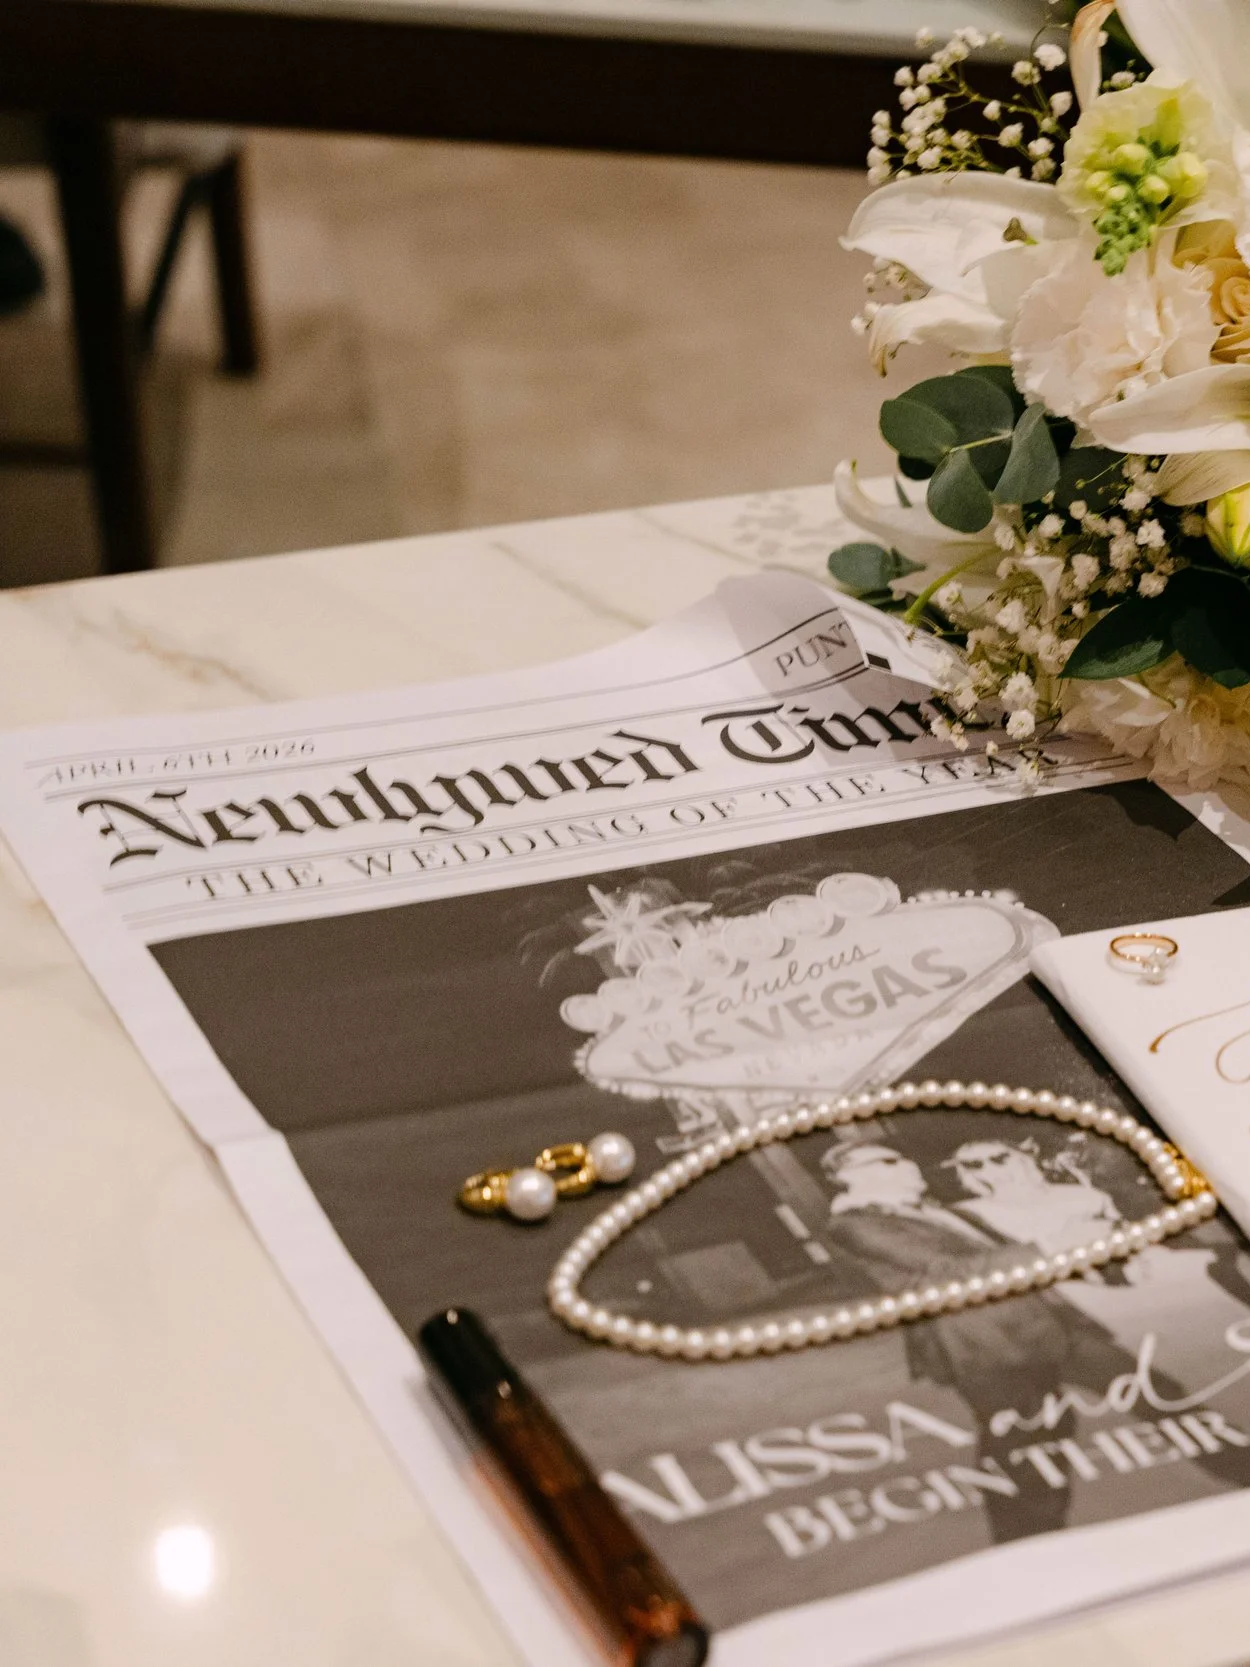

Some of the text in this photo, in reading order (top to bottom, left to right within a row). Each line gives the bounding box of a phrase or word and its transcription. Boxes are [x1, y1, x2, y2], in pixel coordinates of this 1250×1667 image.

[76, 695, 1012, 868] Newlywed Tim
[245, 739, 315, 762] 2026
[186, 860, 322, 898] THE
[348, 813, 648, 878] WEDDING
[669, 796, 737, 828] OF
[760, 773, 886, 808] THE
[631, 1028, 735, 1075] LAS
[737, 947, 968, 1040] VEGAS
[680, 944, 881, 1030] Fabulous
[600, 1401, 976, 1524] ALISSA
[763, 1455, 1019, 1559] BEGIN
[1009, 1408, 1250, 1488] THEIR
